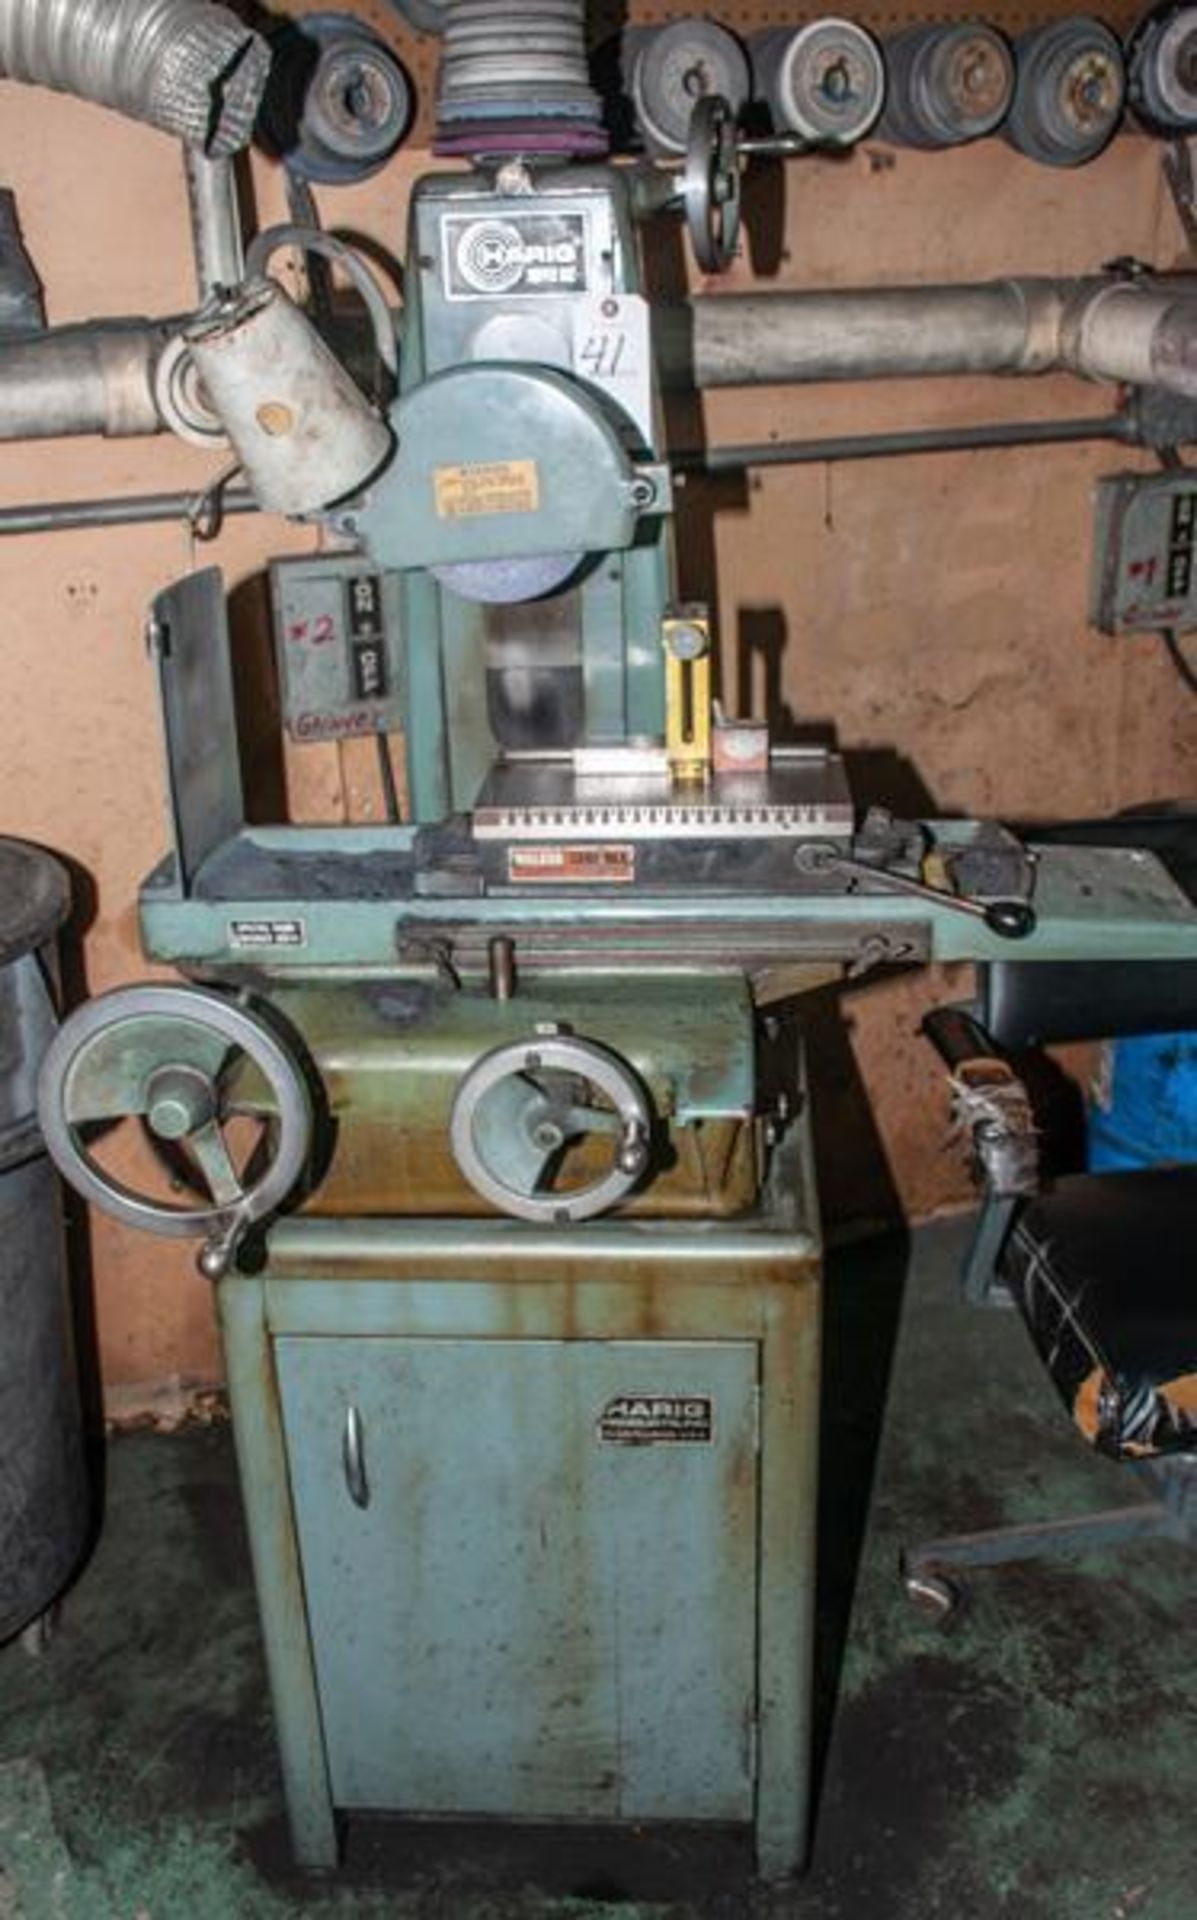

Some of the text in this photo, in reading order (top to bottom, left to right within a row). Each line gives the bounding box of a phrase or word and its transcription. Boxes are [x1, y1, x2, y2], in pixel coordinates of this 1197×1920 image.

[580, 333, 625, 377] 41
[354, 583, 373, 612] ON
[360, 651, 379, 692] OFF
